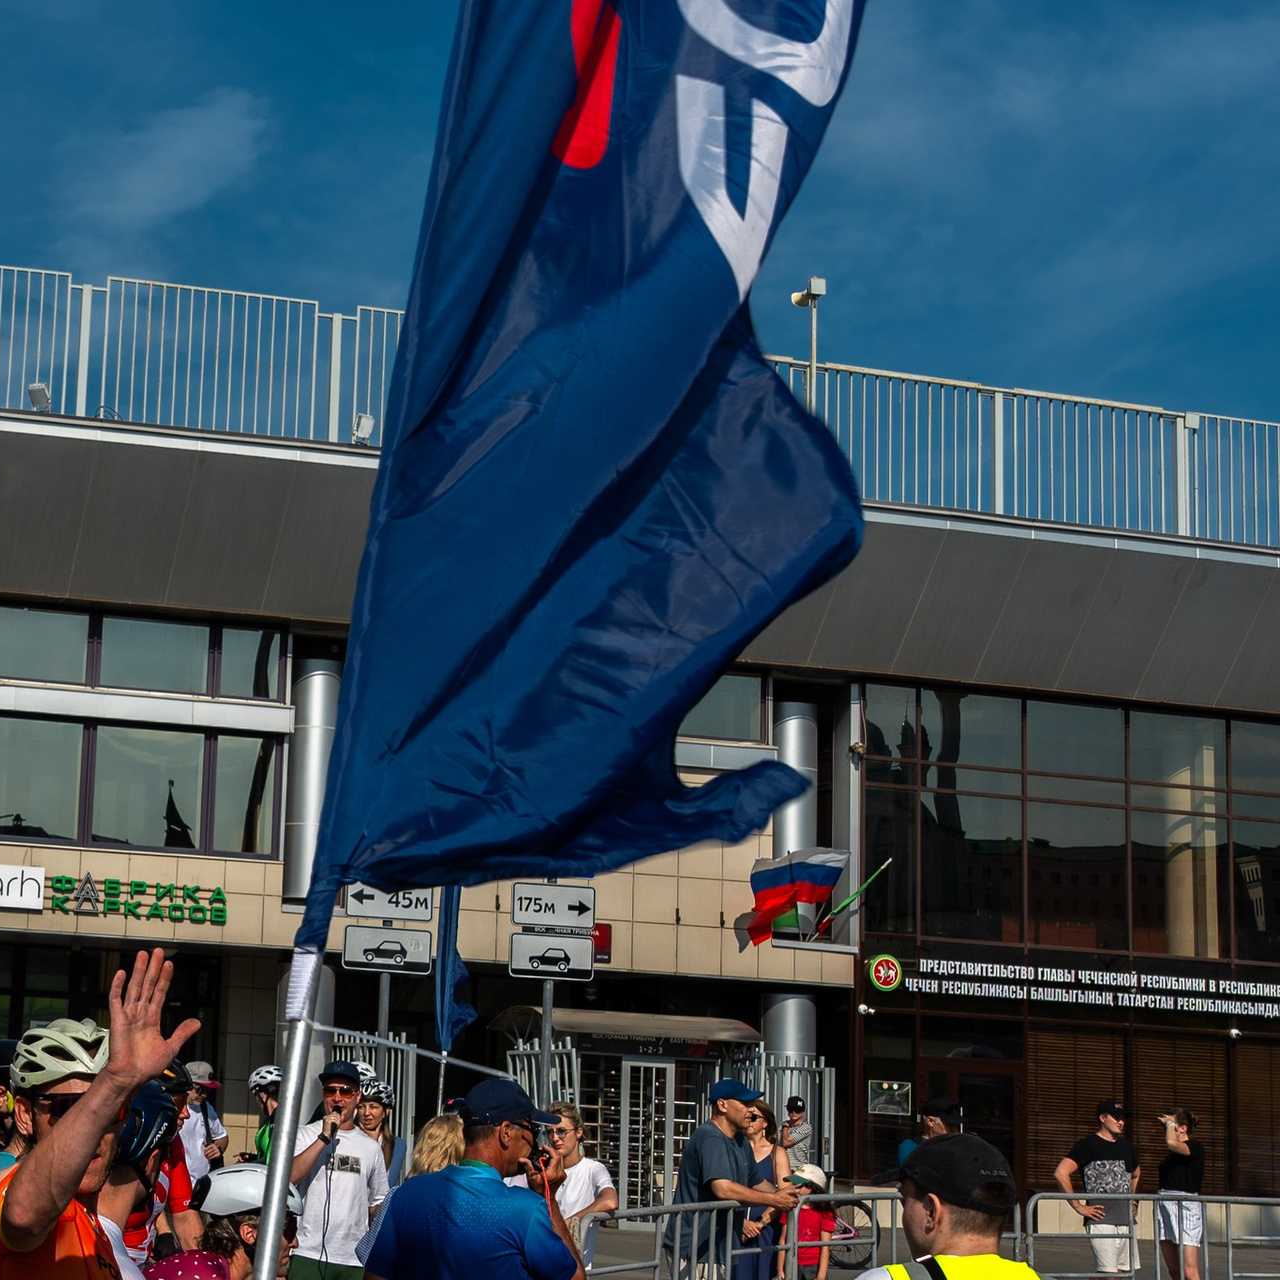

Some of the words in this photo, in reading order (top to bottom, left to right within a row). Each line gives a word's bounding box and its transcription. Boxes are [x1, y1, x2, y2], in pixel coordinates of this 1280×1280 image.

[52, 871, 227, 905] ФАБРИКА
[52, 893, 228, 924] КАРКАСОВ
[919, 958, 1035, 980] ПРЕДСТАВИТЕЛЬСТВО
[1037, 967, 1075, 983] ГЛАВЫ
[1078, 969, 1138, 988] ЧЕЧЕНСКОЙ
[1140, 974, 1206, 992] РЕСПУБЛИКИ
[1209, 979, 1216, 991] В
[905, 978, 938, 993] ЧЕЧЕН
[941, 980, 1027, 999] РЕСПУБЛИКАСЫ
[1117, 992, 1174, 1010] ТАТАРСТАН
[1177, 997, 1280, 1018] РЕСПУБЛИКАСЫНДА
